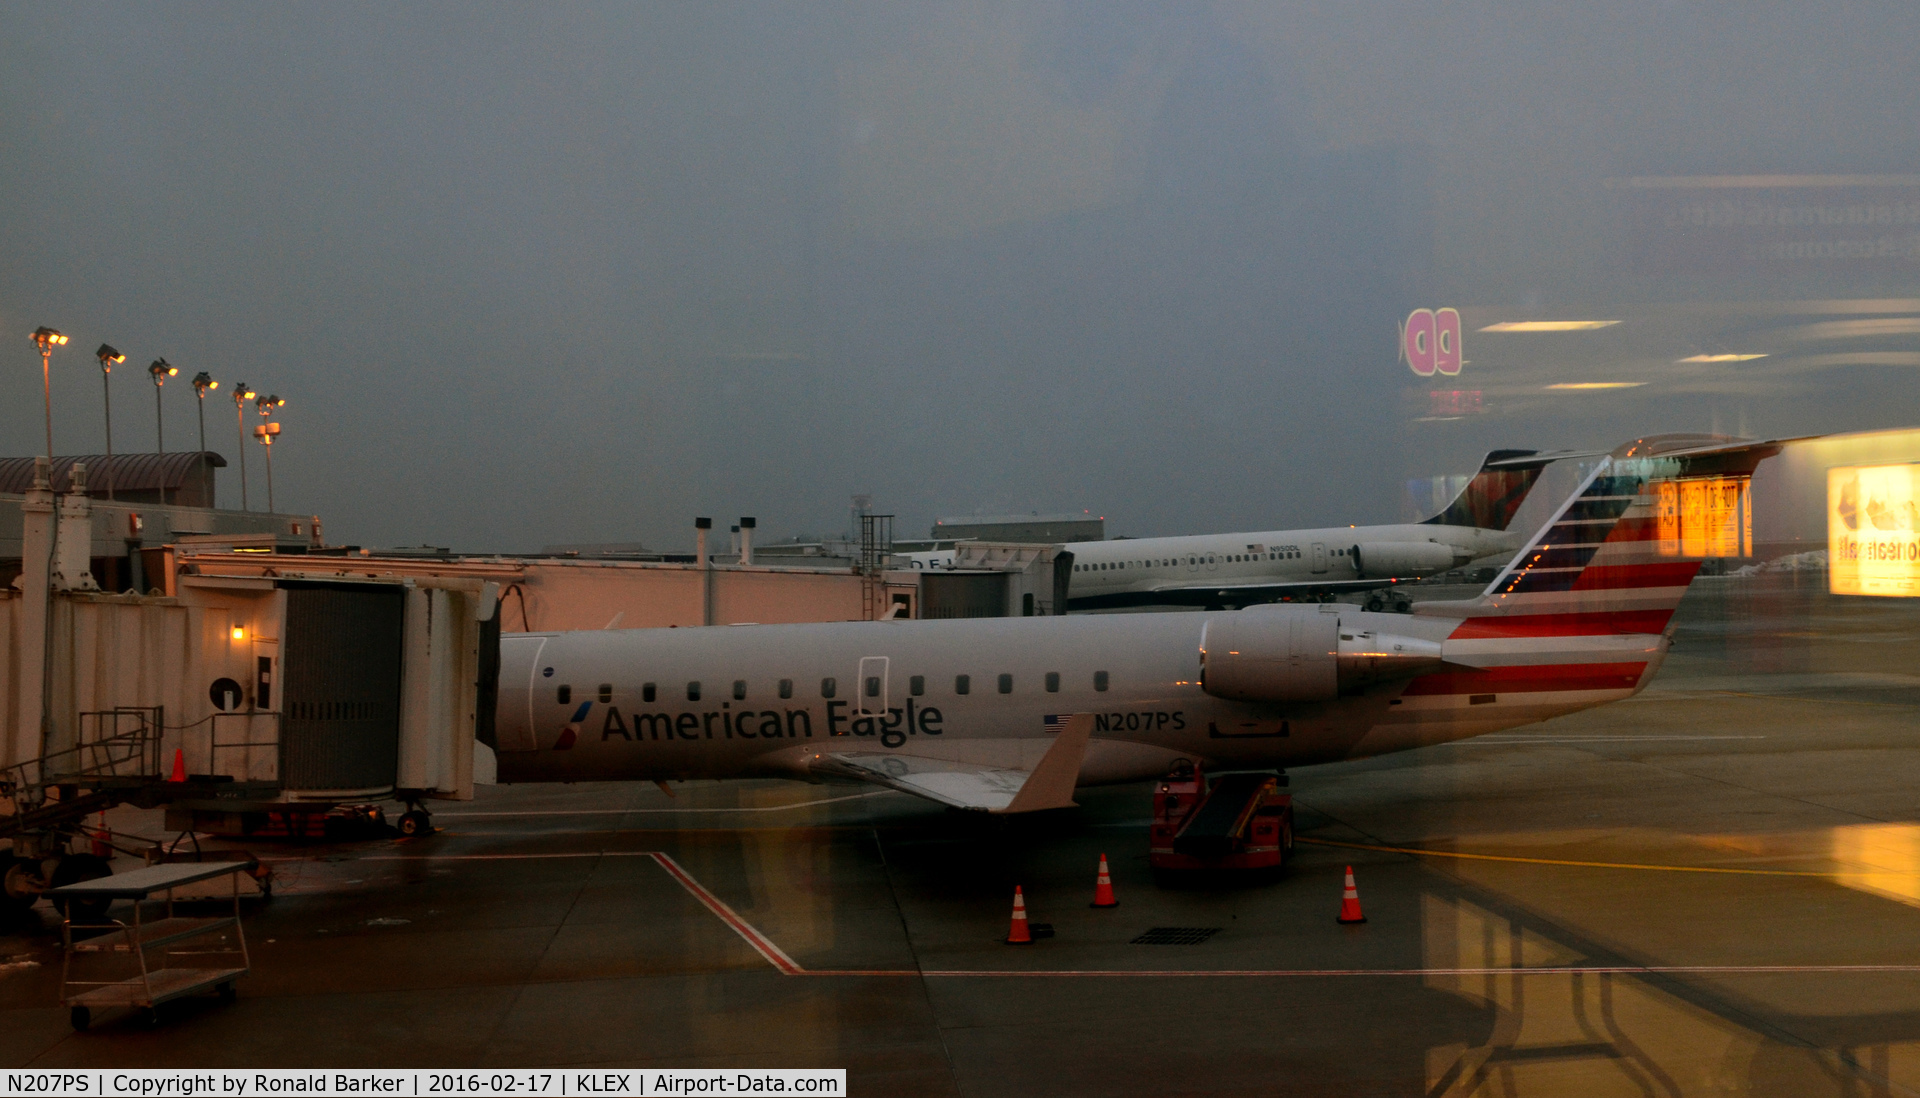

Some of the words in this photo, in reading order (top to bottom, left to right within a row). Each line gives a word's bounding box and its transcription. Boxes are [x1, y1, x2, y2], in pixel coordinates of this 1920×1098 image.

[601, 702, 812, 742] American
[827, 698, 943, 748] Eagle
[1095, 711, 1186, 732] N207PS
